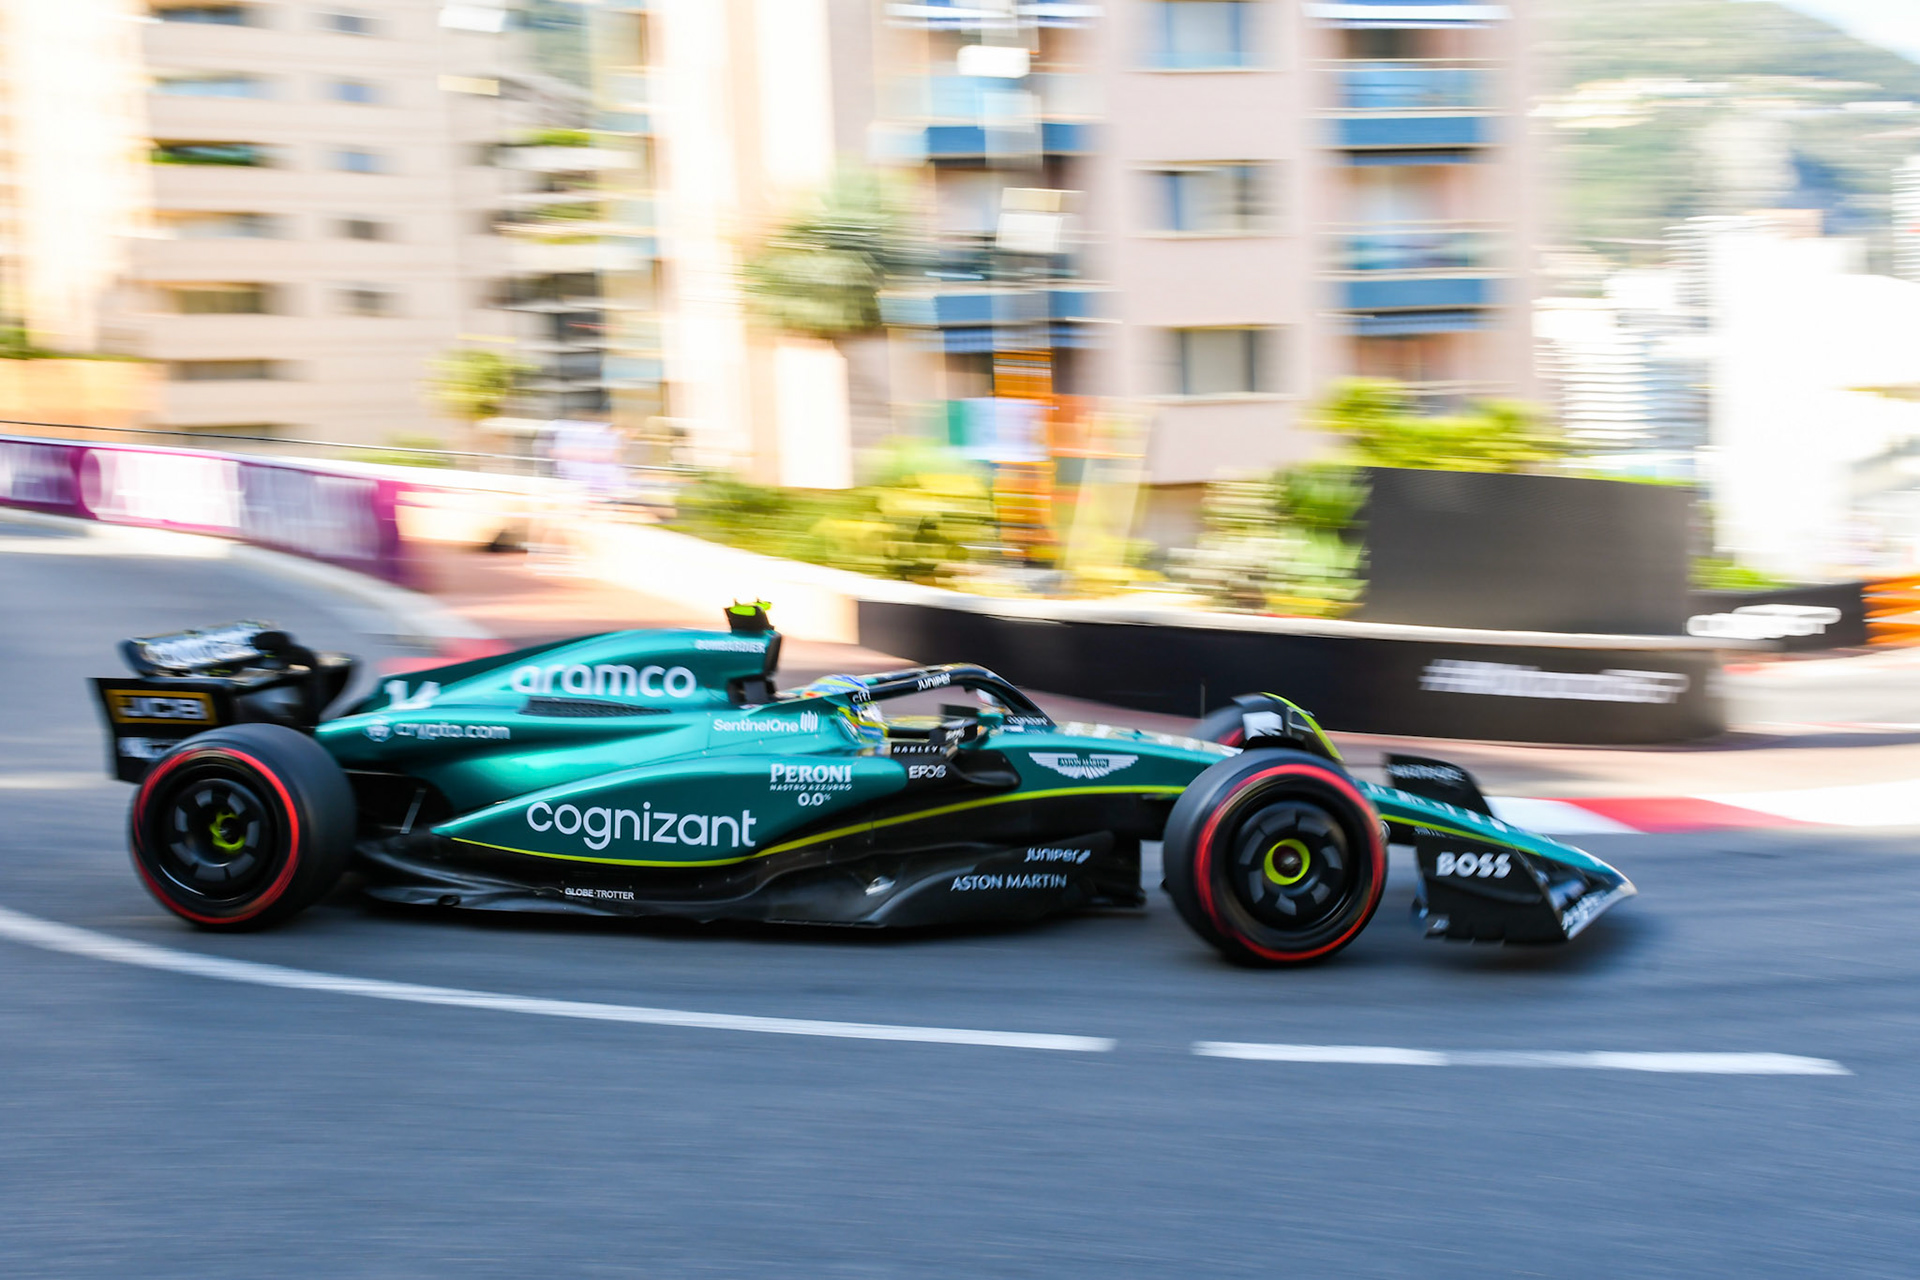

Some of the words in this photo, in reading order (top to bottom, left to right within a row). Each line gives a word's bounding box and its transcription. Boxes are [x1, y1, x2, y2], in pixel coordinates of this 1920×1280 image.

[510, 664, 697, 698] aramco
[120, 697, 208, 719] JCB
[393, 721, 511, 740] crypto.com
[713, 718, 799, 733] SentinelOne
[908, 764, 947, 779] EPOS
[1060, 758, 1082, 767] ASTON
[1082, 758, 1109, 768] MARTIN
[770, 763, 852, 783] PERONI
[769, 783, 807, 791] NASTRO
[808, 783, 852, 791] AZZURRO
[526, 801, 757, 850] cognizant
[1436, 851, 1512, 879] BOSS
[950, 873, 1003, 892] ASTON
[1005, 873, 1067, 889] MARTIN
